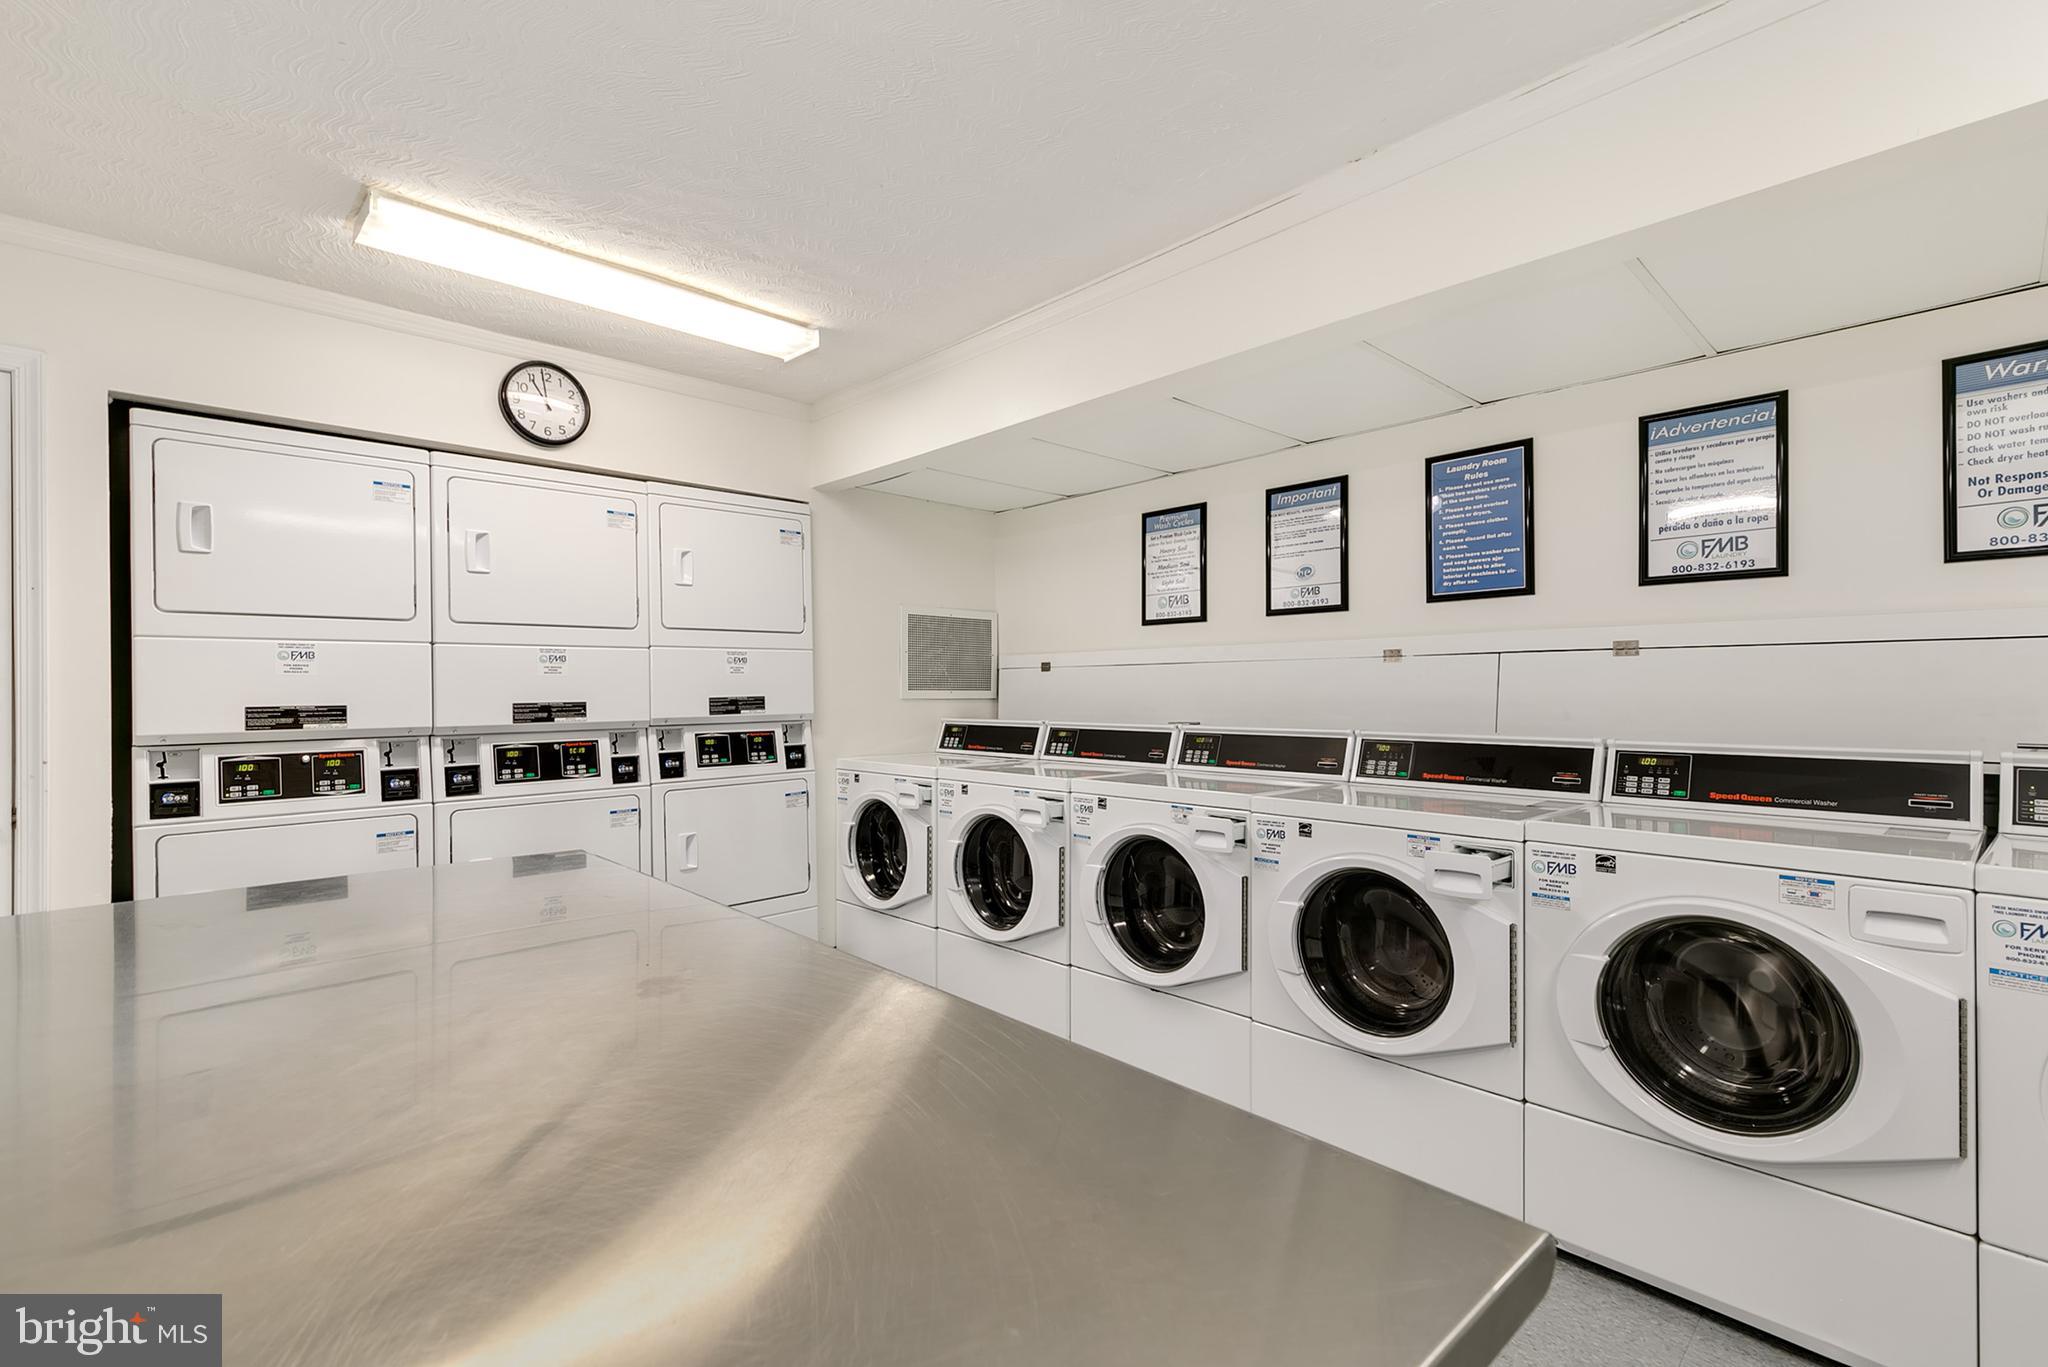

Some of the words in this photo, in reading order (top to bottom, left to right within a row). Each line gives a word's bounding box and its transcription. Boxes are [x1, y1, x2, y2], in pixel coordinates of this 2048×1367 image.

[1984, 360, 2048, 380] War
[516, 382, 528, 392] 10
[558, 378, 562, 388] 1
[568, 390, 575, 400] 2
[1987, 393, 2028, 404] washers
[573, 404, 580, 414] 3
[1990, 403, 2007, 412] risk
[517, 409, 525, 419] 8
[530, 420, 536, 429] 7
[569, 417, 575, 426] 4
[1967, 420, 1981, 428] DO
[1985, 416, 2005, 426] NOT
[544, 426, 552, 436] 6
[559, 425, 566, 435] 5
[1967, 433, 1981, 441] DO
[1985, 429, 2005, 439] NOT
[2009, 425, 2035, 436] wash
[1967, 444, 1993, 454] Check
[1997, 440, 2026, 449] water
[1967, 456, 1993, 466] Check
[1998, 452, 2024, 463] dryer
[1446, 463, 1480, 473] Laundry
[1482, 458, 1507, 467] Room
[1464, 472, 1488, 480] Rules
[1968, 476, 1990, 487] Not
[1277, 486, 1337, 506] Important
[1978, 488, 1993, 498] Or
[1998, 484, 2048, 496] Damage
[1173, 518, 1194, 527] Cycles
[1702, 518, 1723, 528] daño
[1735, 516, 1744, 524] la
[1747, 515, 1769, 525] ropa
[1701, 535, 1748, 558] FMB
[1672, 559, 1755, 573] 800-832-6193
[1300, 586, 1320, 598] FMB
[1169, 595, 1189, 608] FMB
[291, 651, 315, 661] FMB
[1709, 792, 1740, 801] Speed
[1740, 794, 1773, 803] Queen
[1774, 796, 1812, 805] Commercial
[1813, 799, 1838, 807] Washer
[1267, 829, 1285, 840] FMB
[1547, 861, 1577, 875] FMB
[2018, 952, 2045, 960] PHONE
